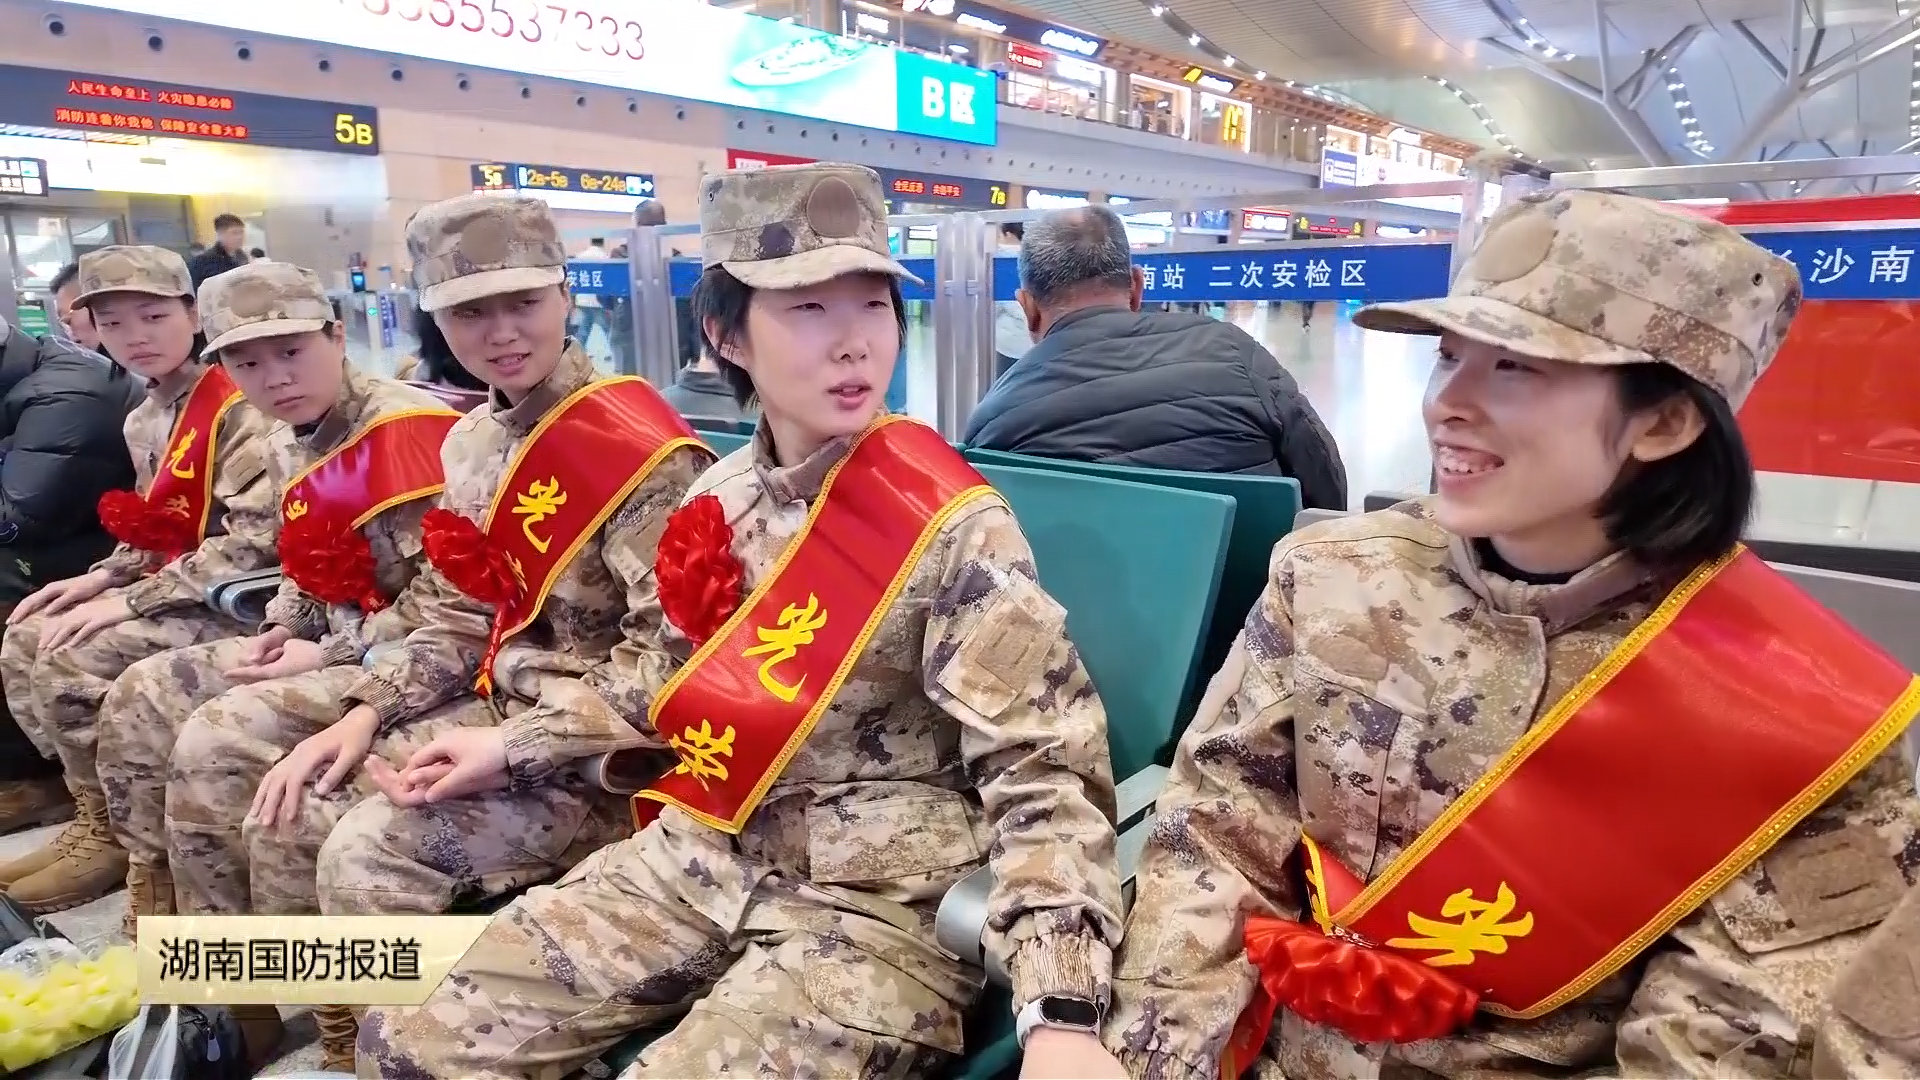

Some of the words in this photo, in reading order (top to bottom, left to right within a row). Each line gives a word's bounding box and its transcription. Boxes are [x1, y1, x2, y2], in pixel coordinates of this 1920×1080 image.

[921, 76, 946, 118] B
[949, 81, 976, 125] 区
[334, 113, 374, 145] 5B
[1208, 259, 1367, 290] 二次安检区
